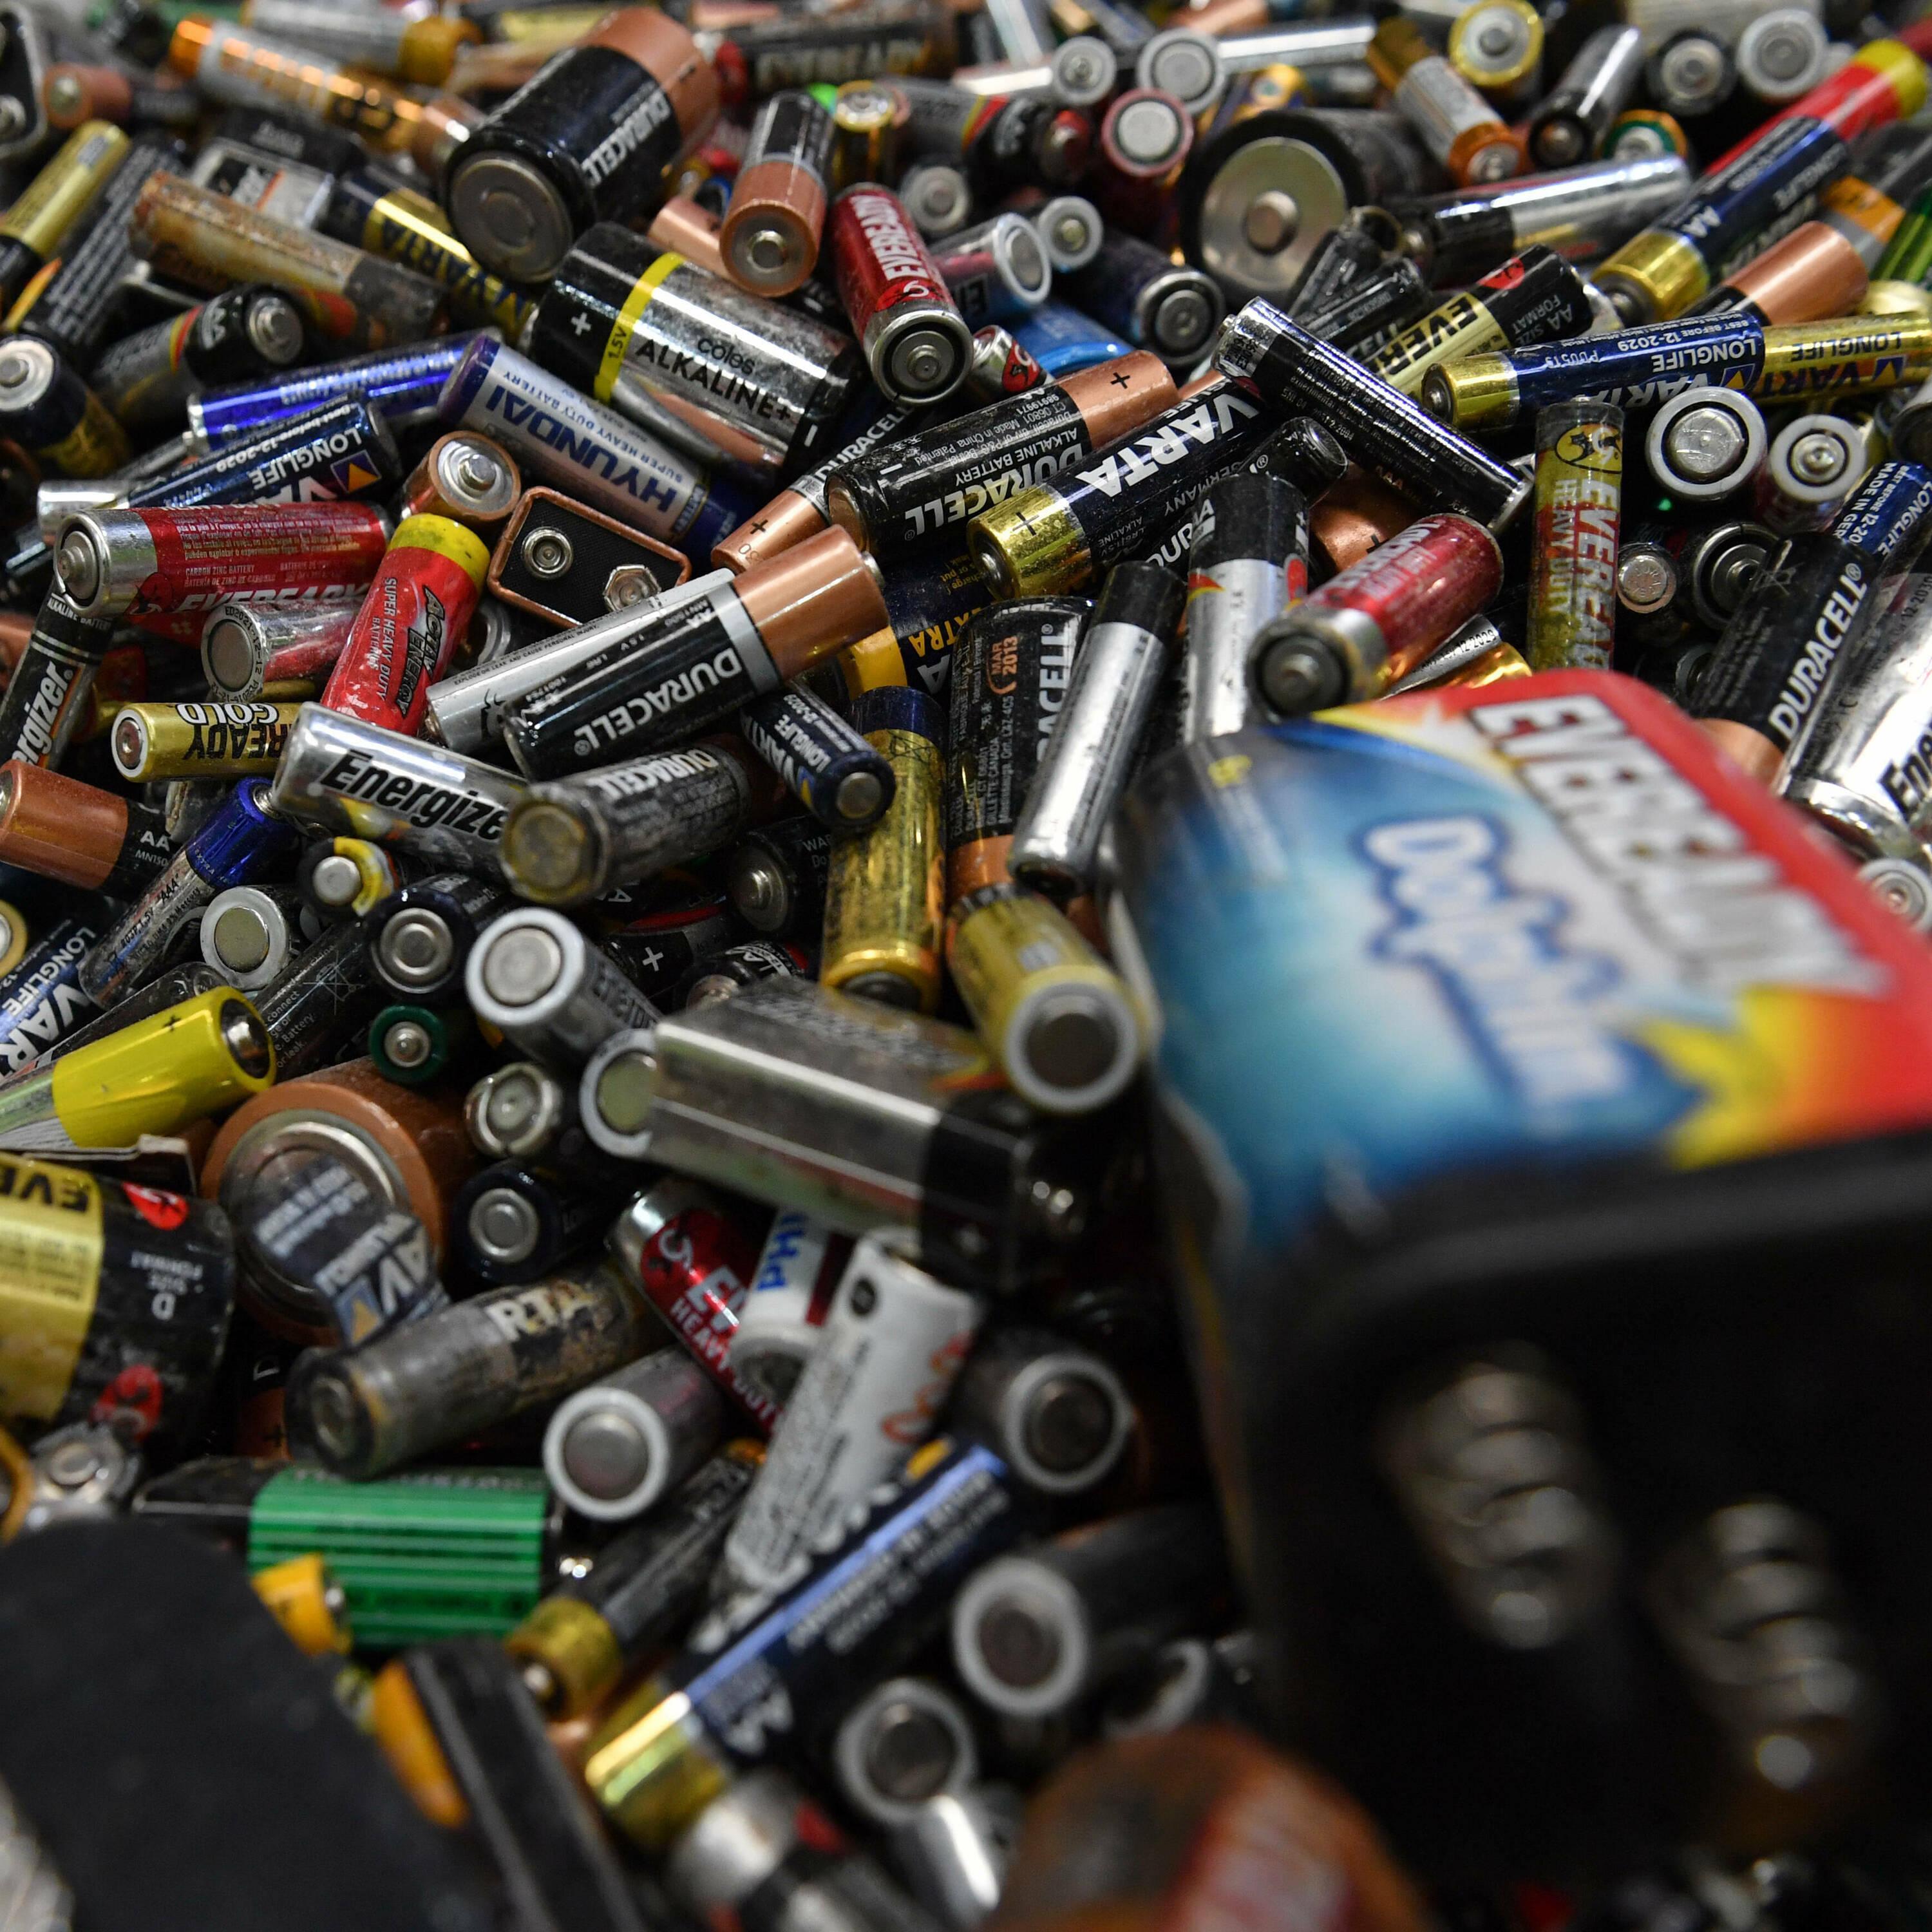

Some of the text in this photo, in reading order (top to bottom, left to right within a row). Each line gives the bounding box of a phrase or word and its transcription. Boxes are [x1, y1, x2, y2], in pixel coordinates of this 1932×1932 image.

[1510, 293, 1562, 334] FORMAT
[1546, 303, 1577, 332] AA
[1367, 296, 1479, 383] EVER
[1615, 318, 1750, 350] BEST BEFORE 12-2029
[1791, 332, 1901, 361] LONGLIFE
[694, 330, 759, 376] coles
[1649, 337, 1757, 370] LONGLIFE
[500, 368, 562, 411] BATTERY
[633, 334, 795, 427] ALKALINE+
[1582, 372, 1710, 410] VART
[1753, 362, 1858, 398] VART
[561, 404, 596, 431] DUTY
[992, 417, 1020, 437] Made
[1021, 406, 1051, 425] 06801
[483, 383, 678, 514] HYUNDAI
[596, 426, 639, 457] HEAVY
[956, 432, 984, 451] China
[983, 428, 994, 440] in
[1074, 383, 1260, 508] VARTA
[247, 426, 362, 491] LONGLIFE
[639, 452, 684, 484] SUPER
[913, 444, 955, 468] Patented
[951, 426, 1079, 486] ALKALINE BATTERY
[902, 441, 1085, 534] DURACELL
[1862, 464, 1895, 495] MADE
[1869, 482, 1896, 513] BEFORE
[1551, 478, 1578, 549] HEAVY
[1850, 495, 1871, 513] IN
[1877, 480, 1929, 558] LONGLIFE
[1095, 515, 1144, 547] ALKALINE
[1848, 511, 1879, 544] 12-20
[212, 565, 227, 574] ZINC
[1572, 478, 1617, 670] EVEREAD
[374, 575, 397, 701] SUPER HEAVY DUTY
[1003, 635, 1017, 674] 2013
[1764, 568, 1871, 741] DURACELL
[991, 642, 1003, 673] MAR
[572, 645, 743, 754] DURACELL
[1037, 622, 1075, 761] ACELL
[175, 700, 279, 726] GOLD
[182, 721, 289, 761] READY
[773, 712, 832, 775] LONGLIFE
[319, 748, 509, 841] Energize
[134, 849, 170, 867] MN150
[139, 829, 173, 852] AA
[0, 925, 97, 1017] LONGLIFE
[264, 989, 300, 1023] connect
[0, 986, 89, 1077] VAR
[280, 1012, 316, 1043] Battery
